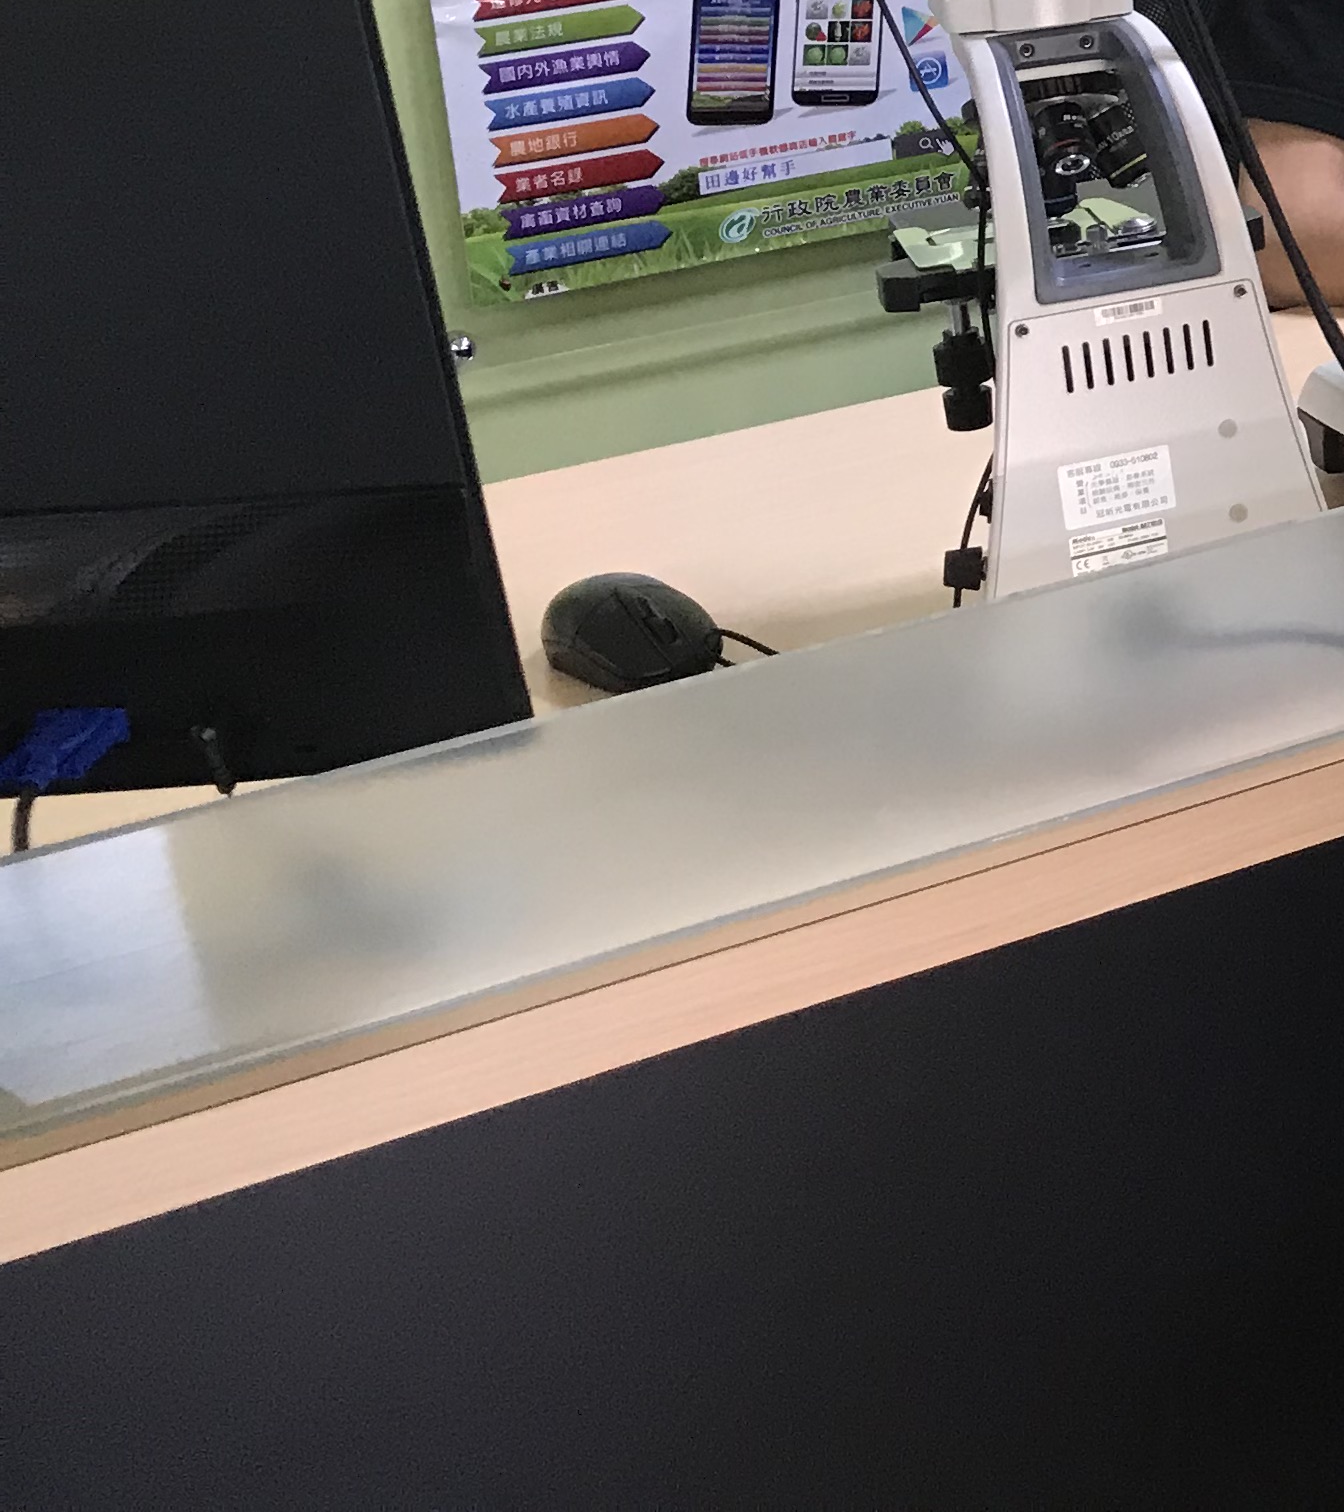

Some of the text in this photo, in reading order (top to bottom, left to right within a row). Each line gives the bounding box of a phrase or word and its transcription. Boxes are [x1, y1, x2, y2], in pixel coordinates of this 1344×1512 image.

[495, 22, 564, 46] 農業法規
[510, 131, 578, 157] 農地銀行
[705, 160, 796, 190] 田邊好幫手
[761, 171, 955, 223] 行政院農業委員會
[936, 192, 960, 205] YUAN
